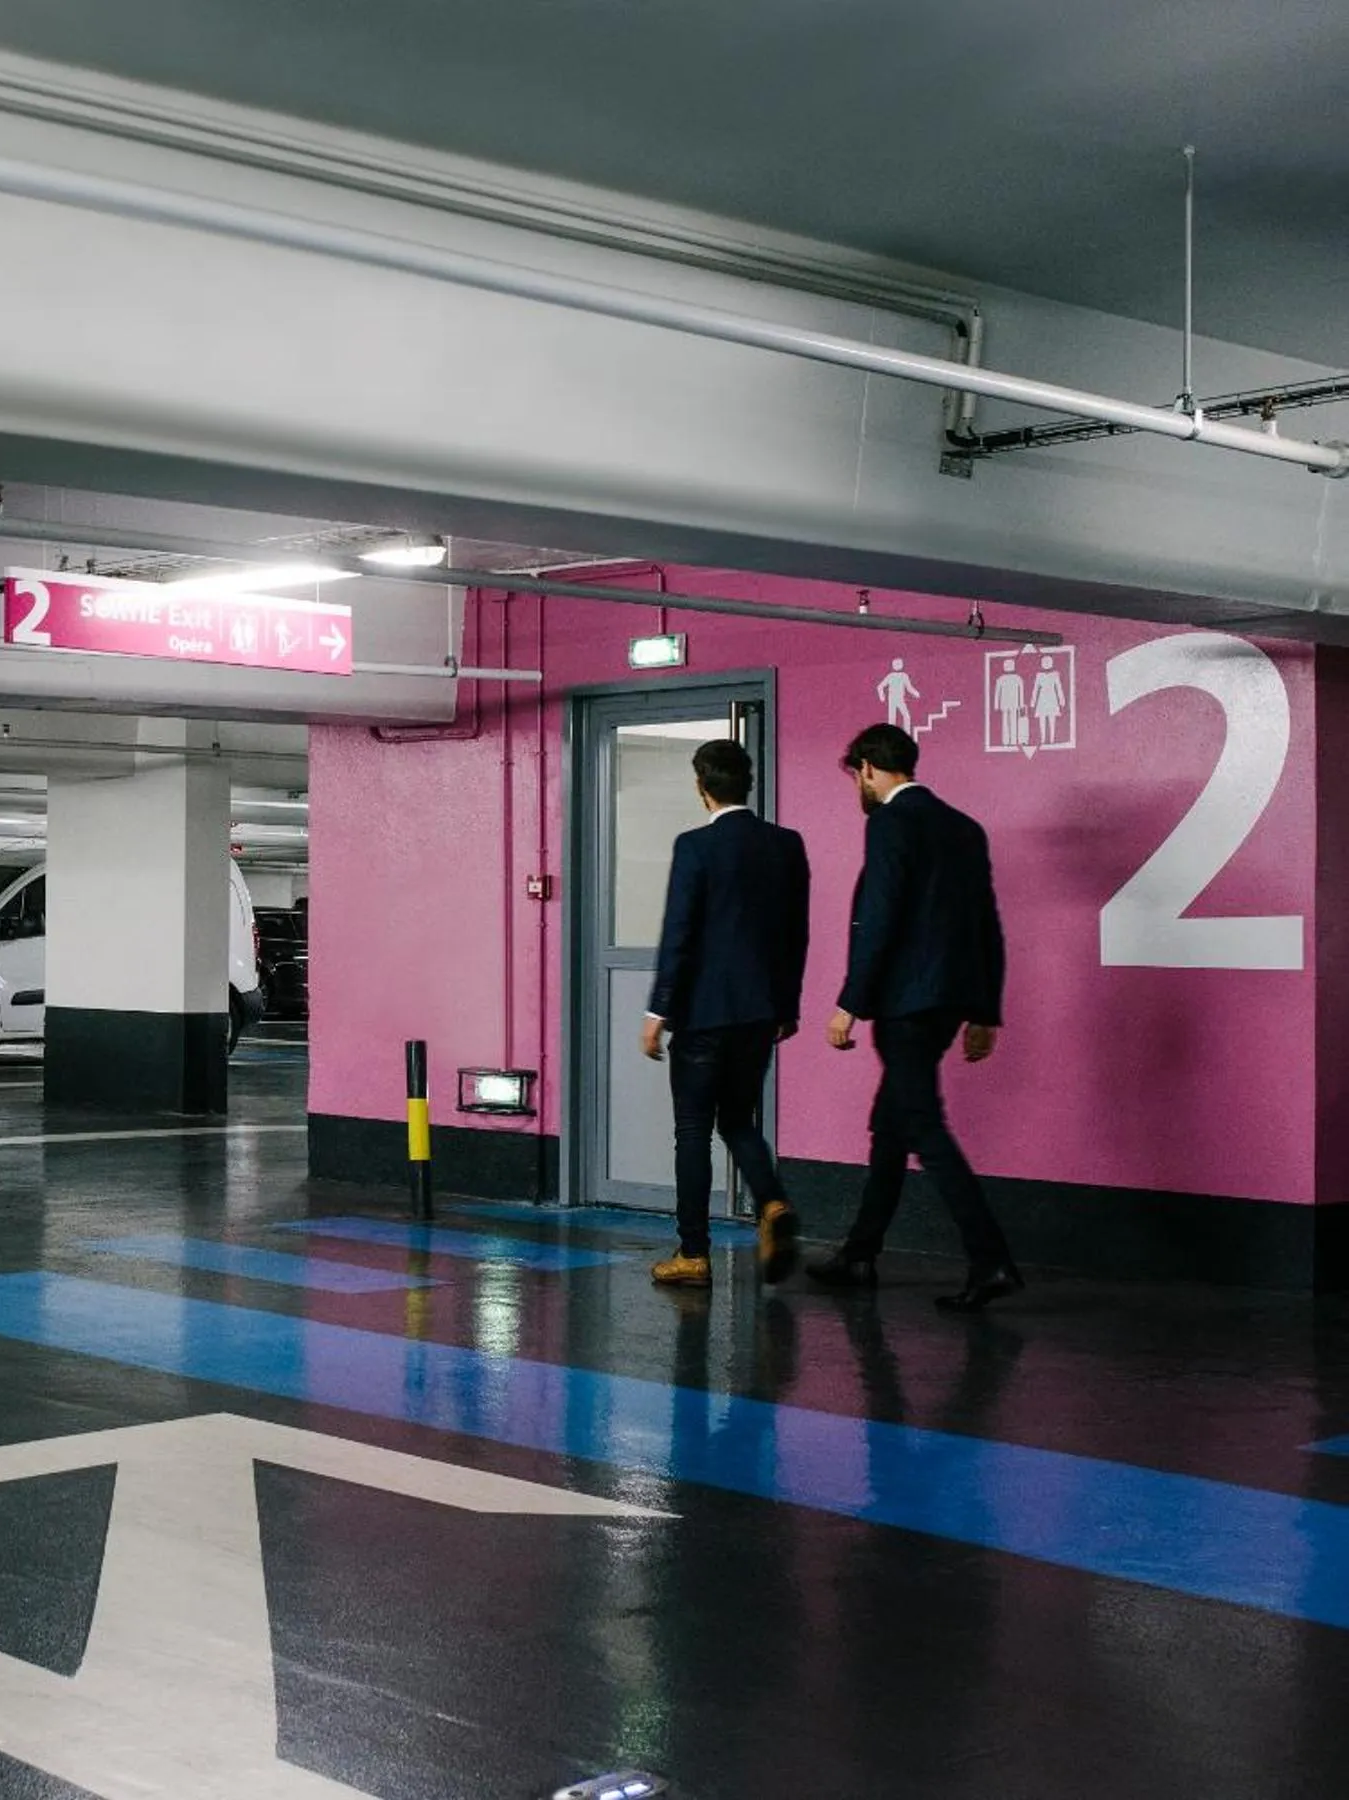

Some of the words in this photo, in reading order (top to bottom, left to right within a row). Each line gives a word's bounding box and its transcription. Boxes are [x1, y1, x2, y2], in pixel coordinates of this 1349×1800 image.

[12, 580, 52, 646] 2
[79, 593, 162, 624] SORTIE
[168, 602, 213, 631] Exit
[1099, 631, 1305, 971] 2
